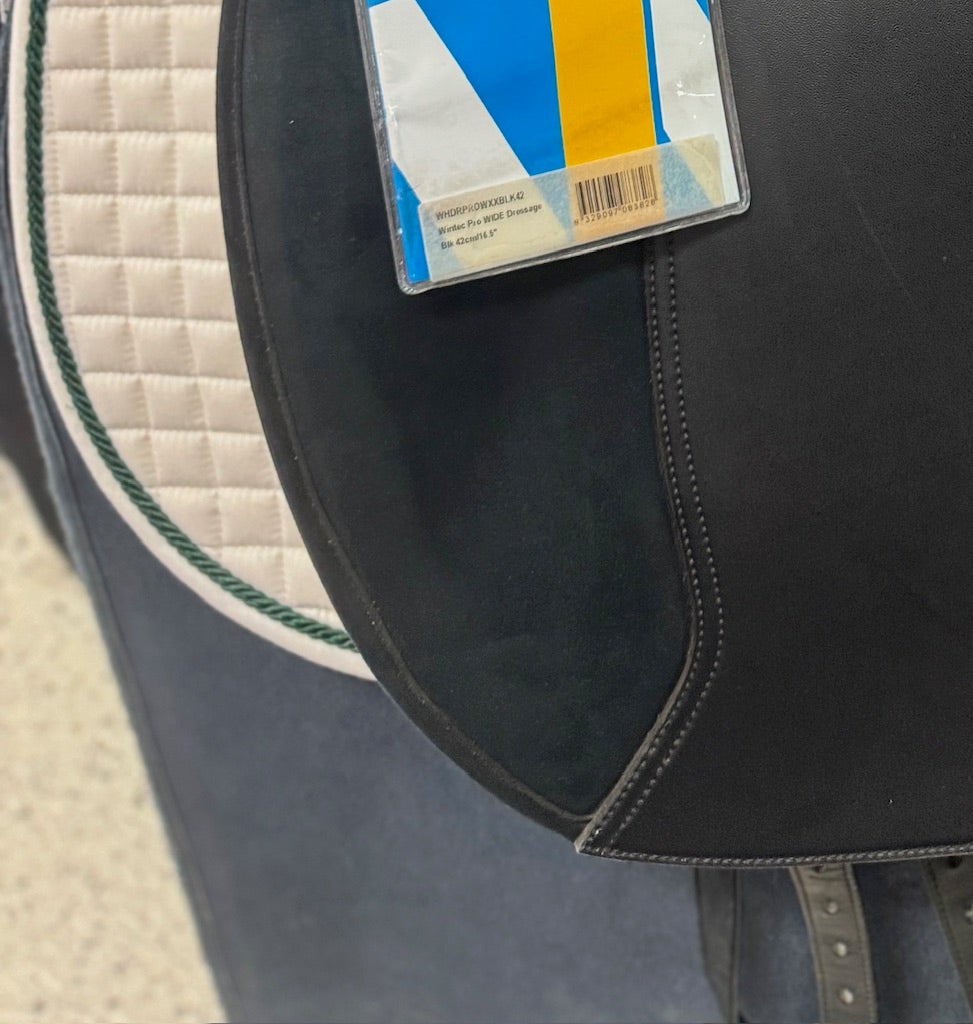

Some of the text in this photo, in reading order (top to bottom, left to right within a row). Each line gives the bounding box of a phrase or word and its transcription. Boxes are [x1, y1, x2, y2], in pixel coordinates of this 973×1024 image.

[438, 204, 543, 236] Wintec Pro WIDE Dressage
[441, 240, 454, 250] Blk
